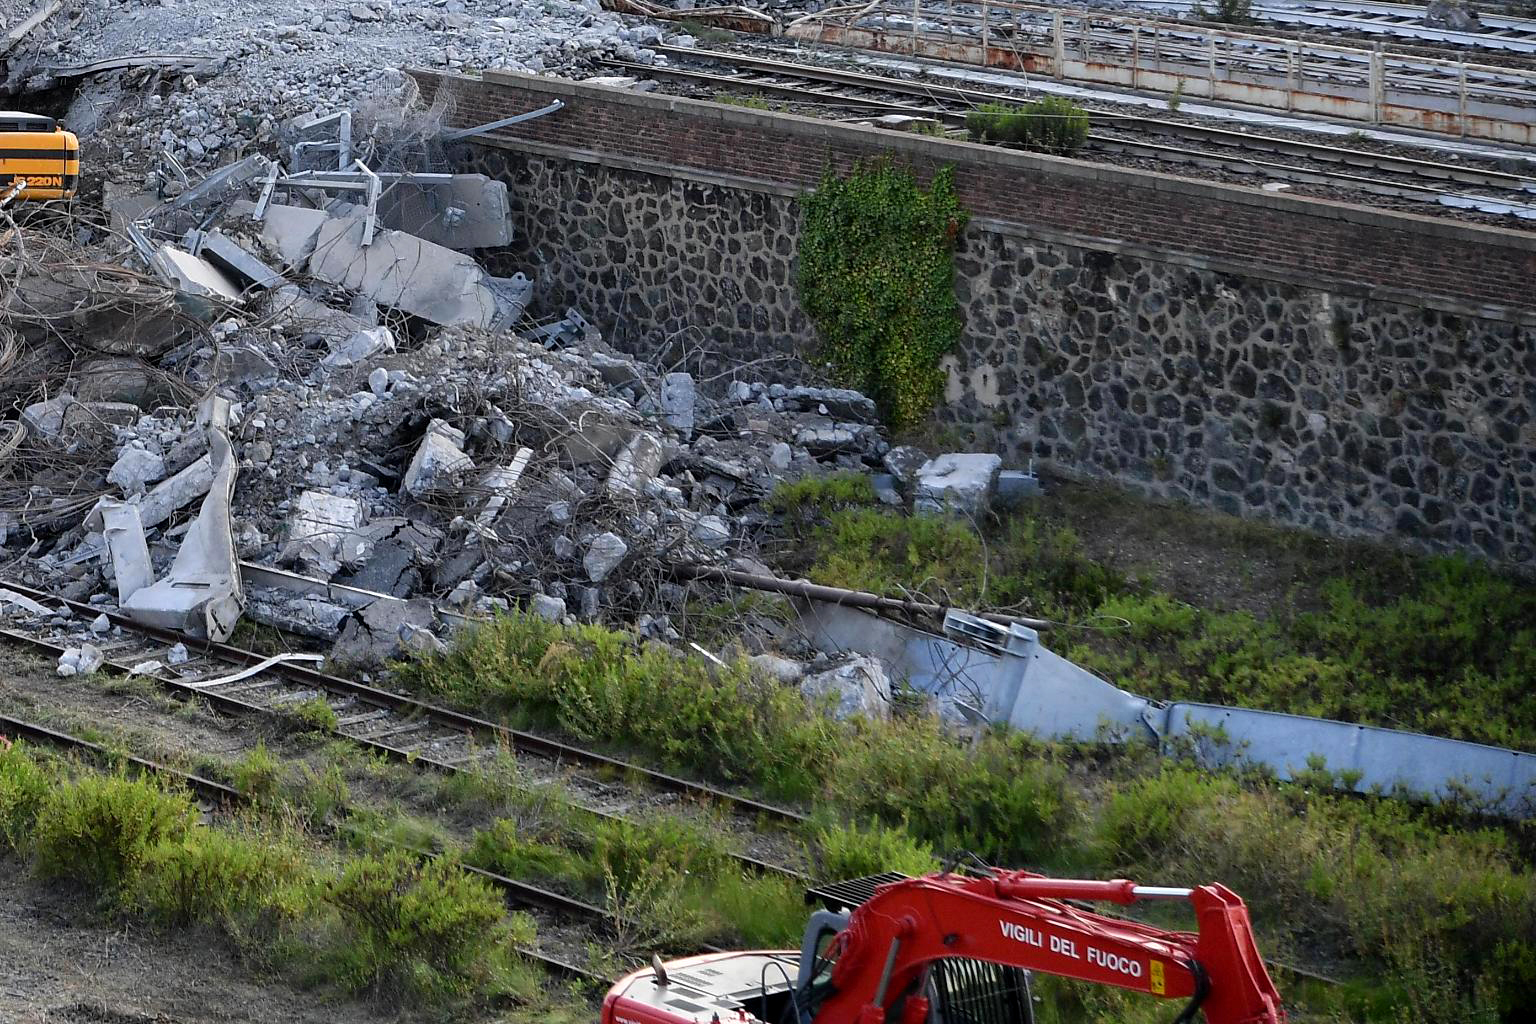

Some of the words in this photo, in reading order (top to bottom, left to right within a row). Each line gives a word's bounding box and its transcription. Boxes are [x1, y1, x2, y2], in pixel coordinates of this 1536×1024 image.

[999, 919, 1043, 947] VIGILI
[1050, 935, 1080, 959] DEL
[1087, 946, 1142, 978] FUOCO
